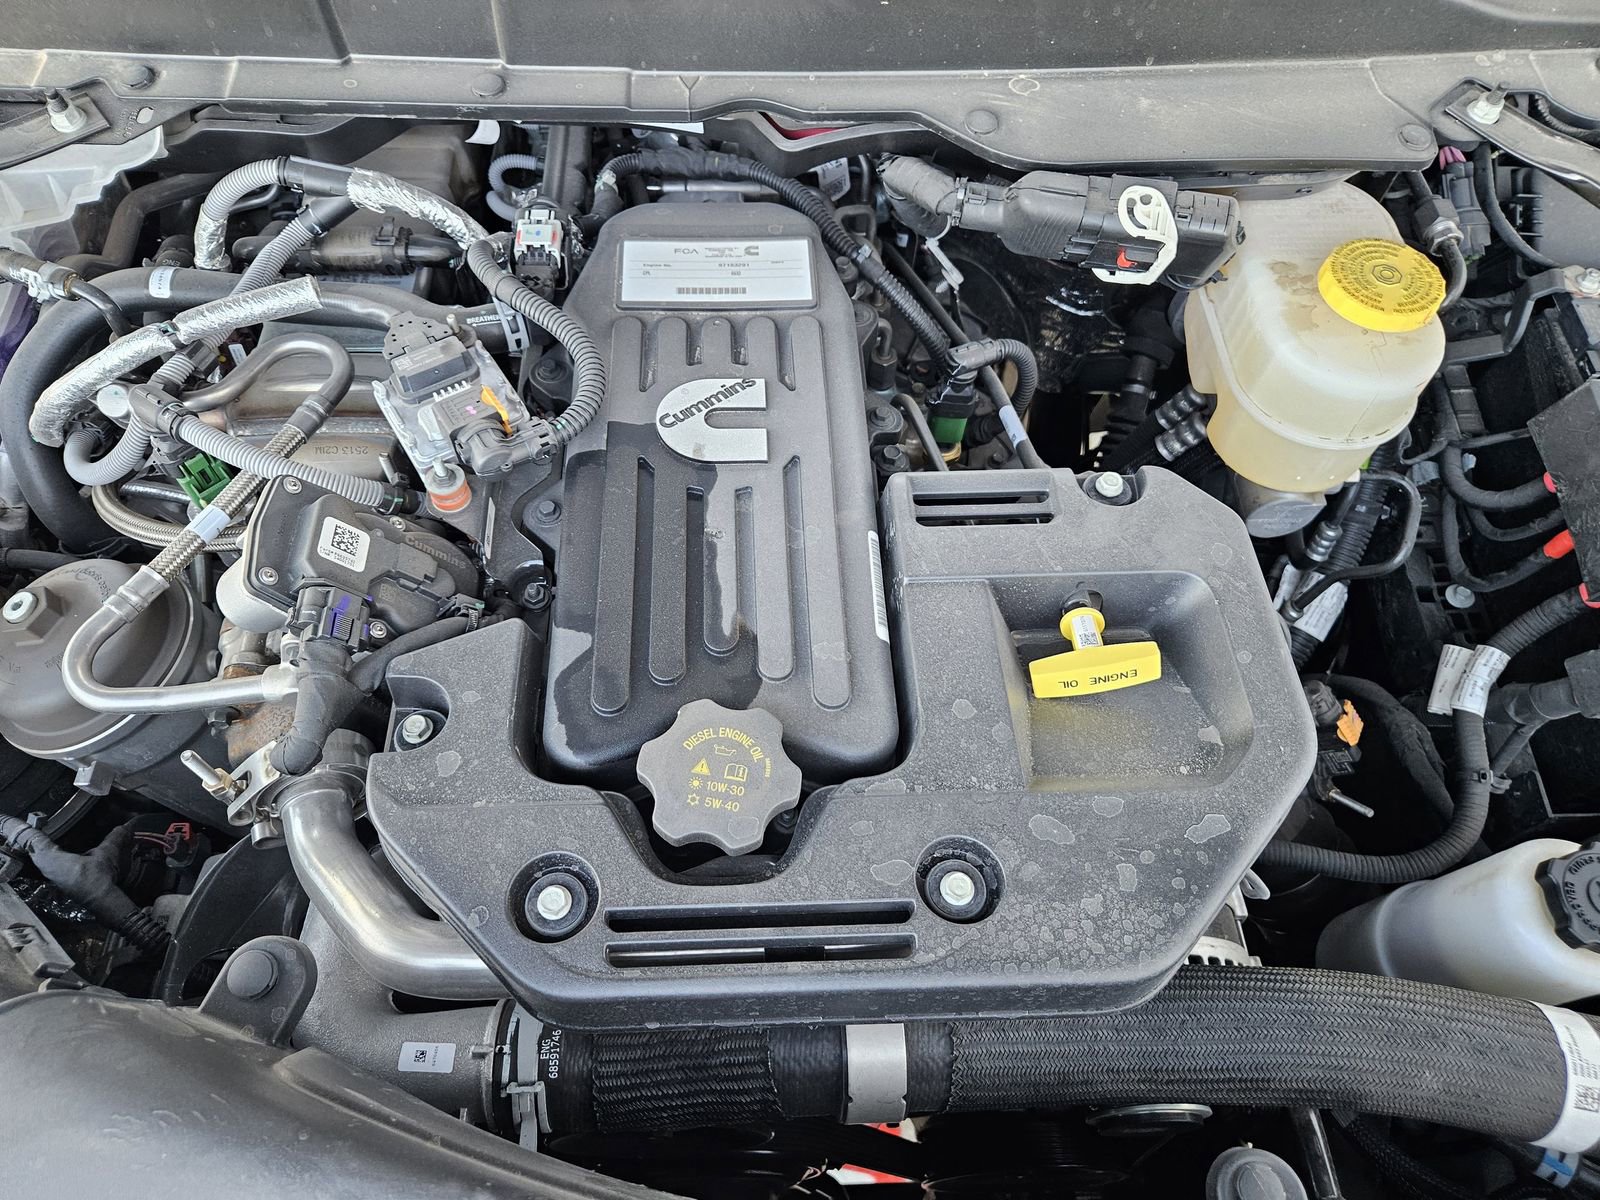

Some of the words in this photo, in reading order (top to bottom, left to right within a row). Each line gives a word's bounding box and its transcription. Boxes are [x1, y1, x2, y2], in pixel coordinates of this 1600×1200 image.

[673, 247, 699, 255] FCA
[466, 314, 502, 324] BREATHE
[658, 377, 757, 429] Cummins
[341, 445, 369, 455] 2513
[405, 534, 467, 569] Cummins
[1058, 679, 1079, 689] OIL
[1089, 668, 1138, 685] ENGINE
[683, 727, 717, 751] DIESEL
[719, 727, 755, 749] ENGINE
[750, 746, 764, 763] OIL
[706, 780, 745, 797] 10W-30
[704, 796, 740, 813] 5W-40
[540, 1038, 551, 1060] ENG
[548, 1029, 562, 1079] 68591746
